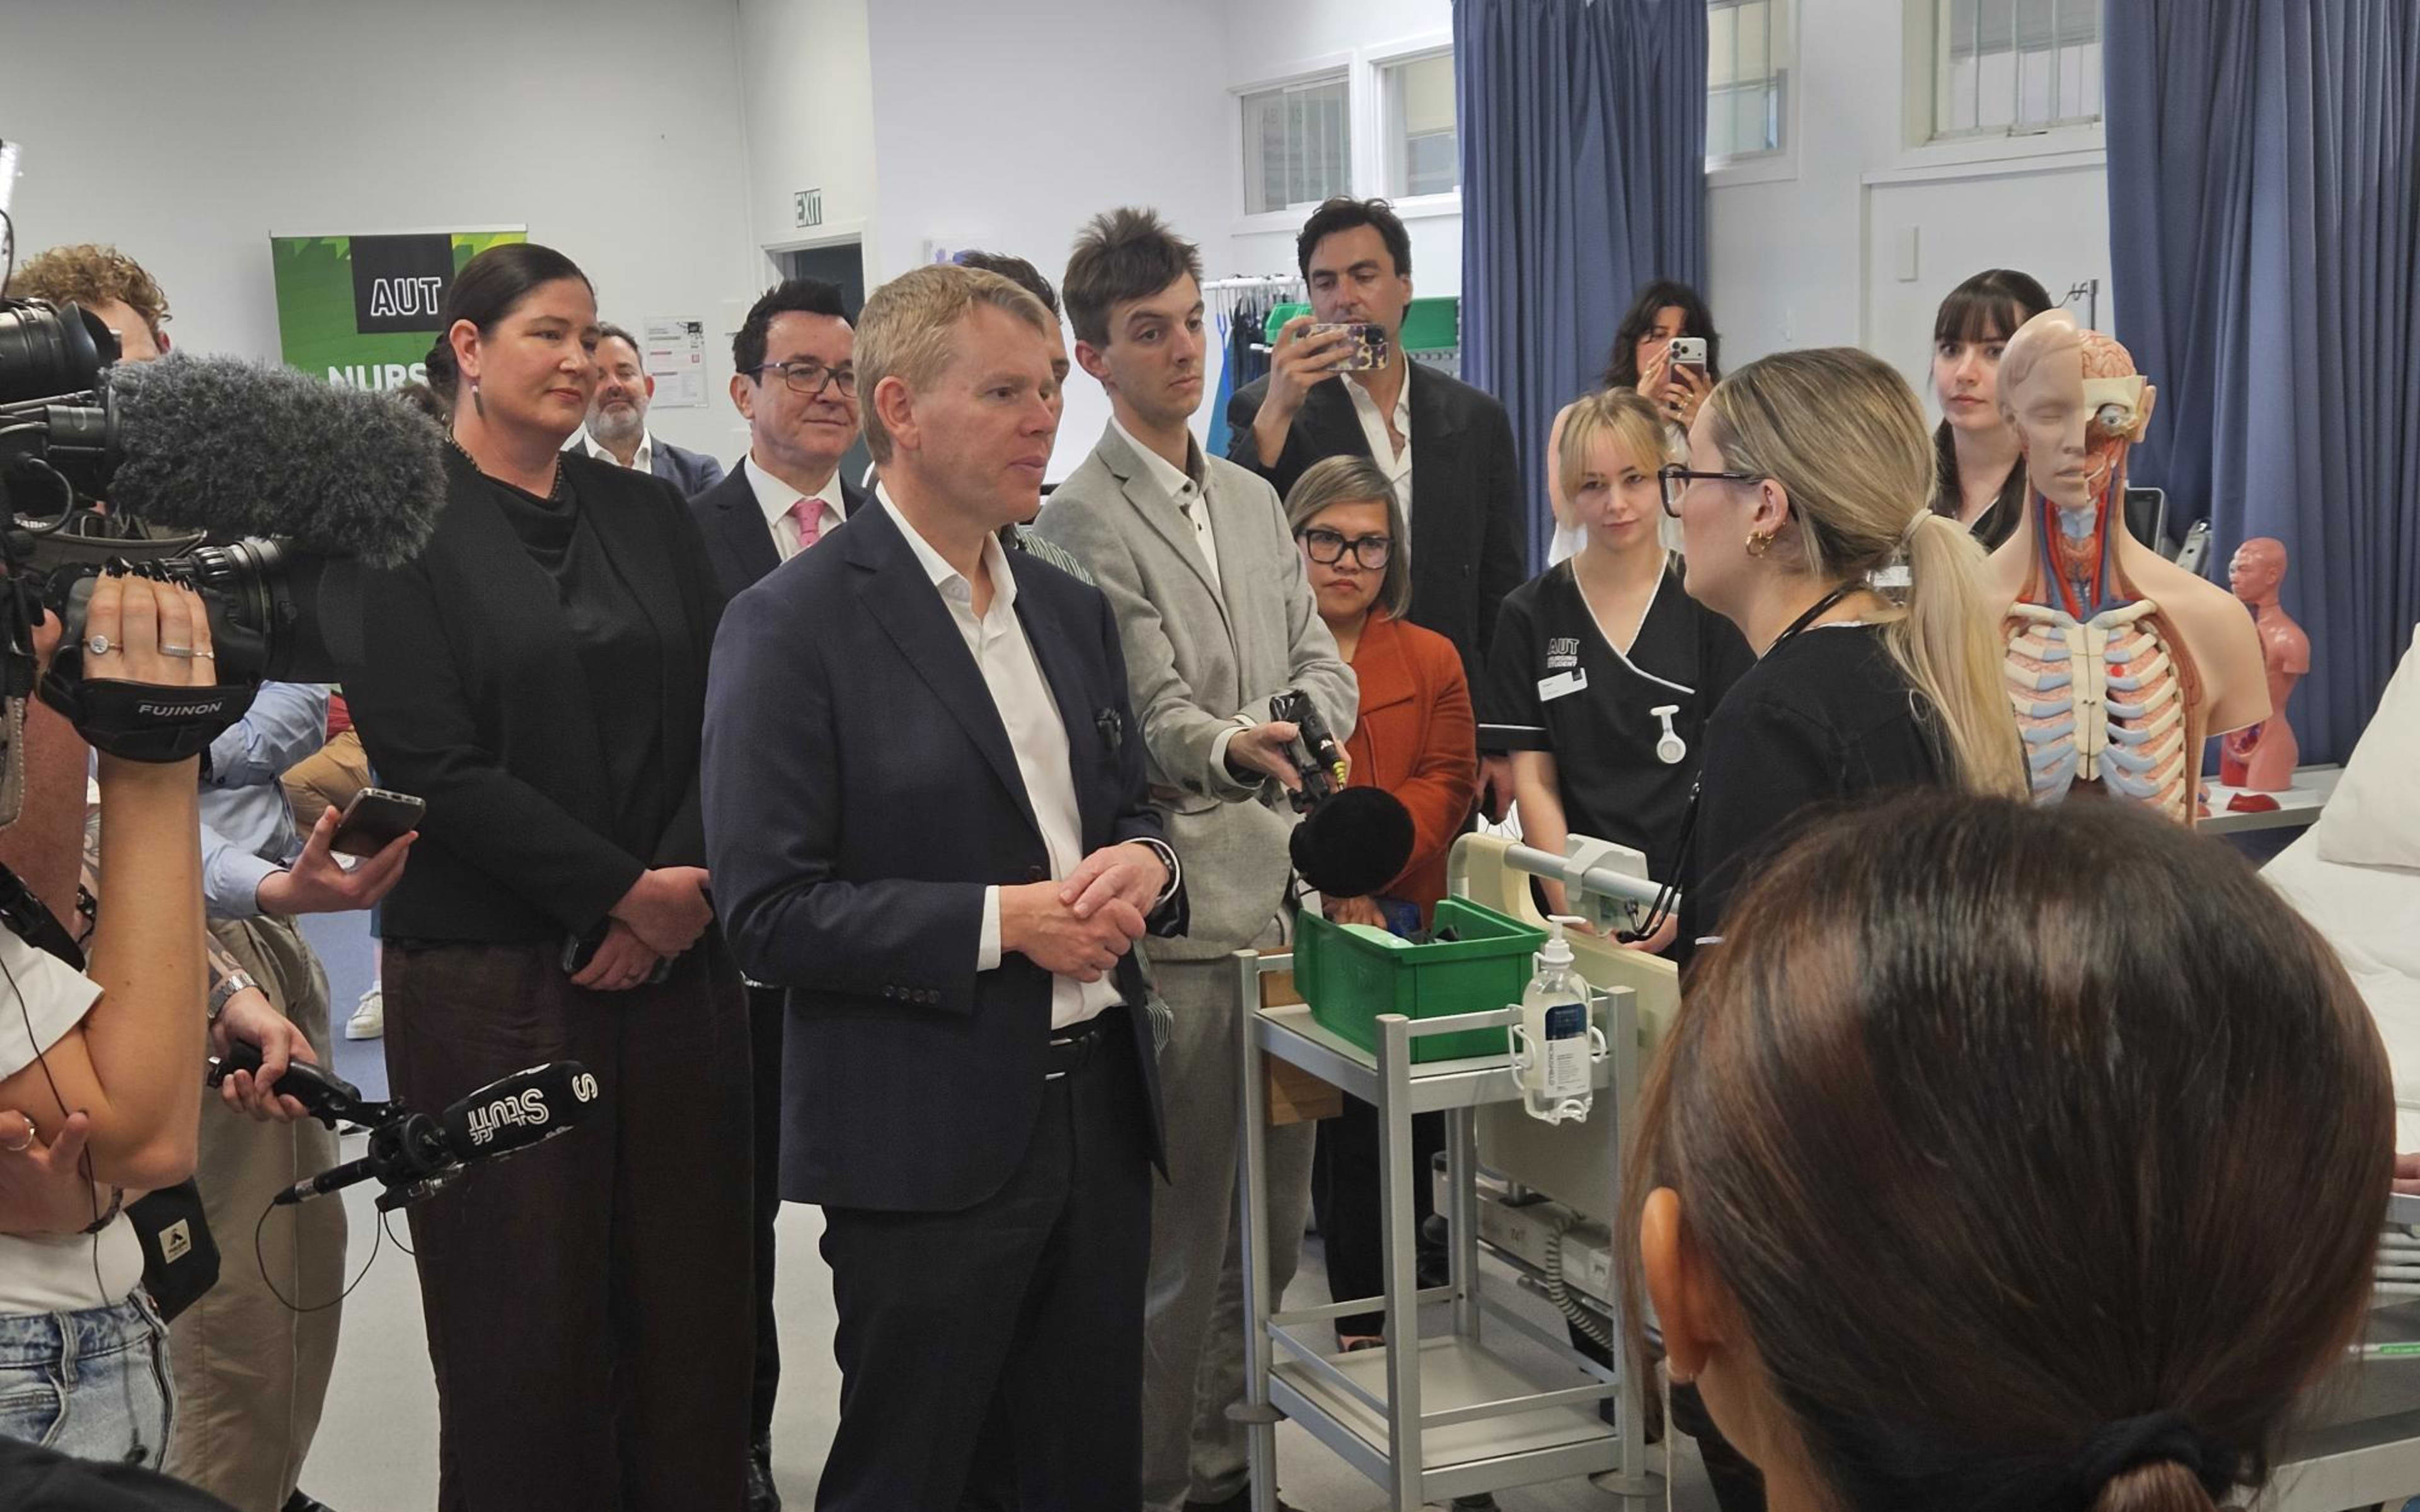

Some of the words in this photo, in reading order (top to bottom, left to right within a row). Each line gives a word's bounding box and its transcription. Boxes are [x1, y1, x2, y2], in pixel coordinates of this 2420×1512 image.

[795, 190, 822, 227] EXIT
[371, 277, 442, 316] AUT
[1547, 638, 1580, 655] AUT
[139, 702, 222, 716] FUJINON
[468, 1088, 549, 1145] Stuff
